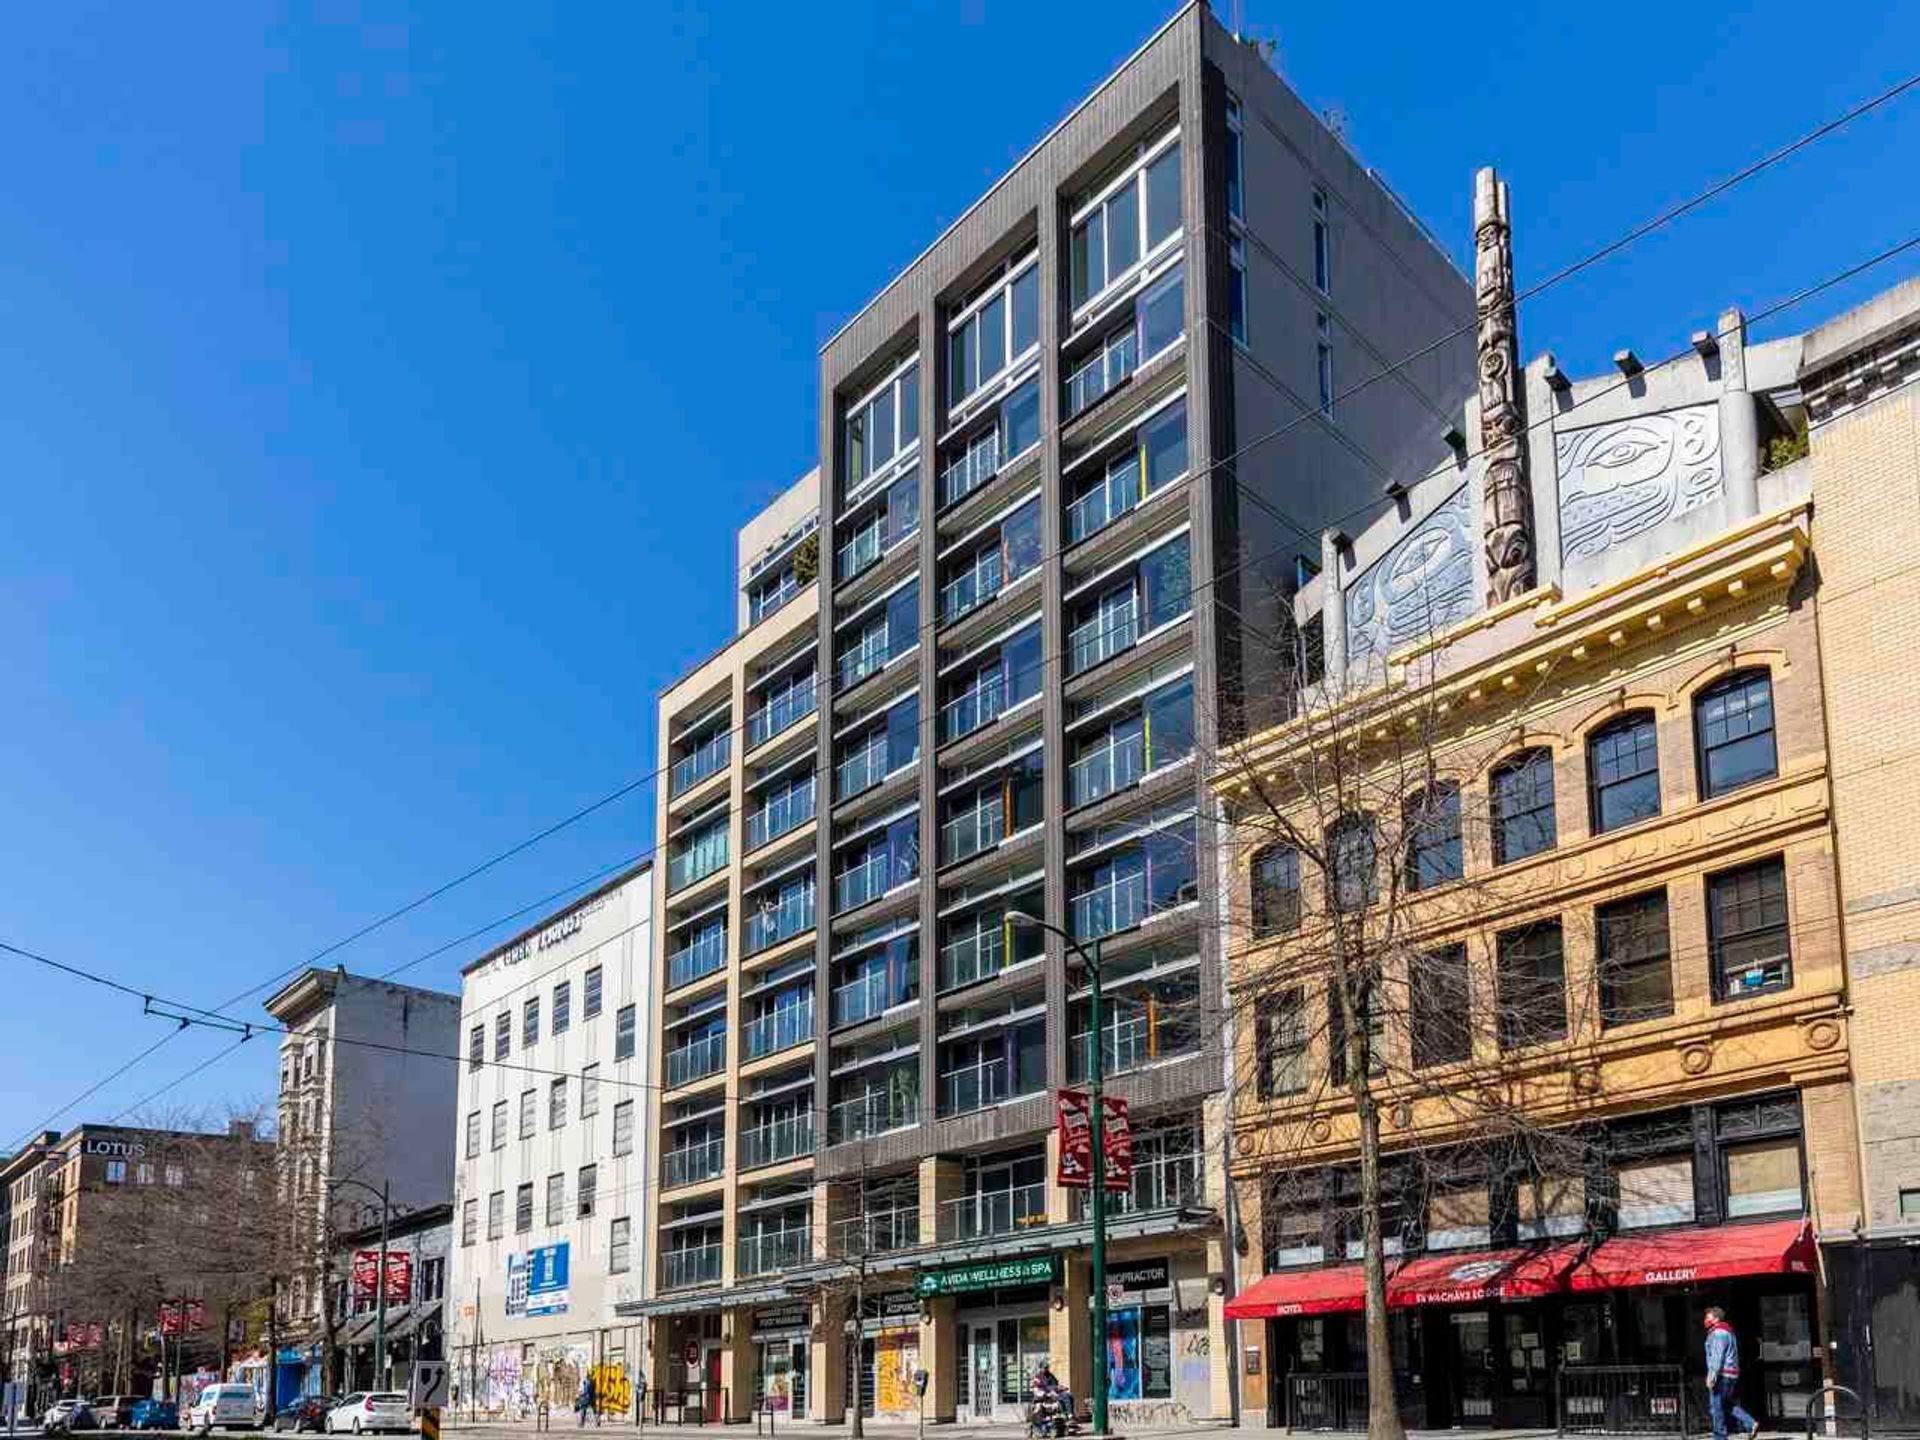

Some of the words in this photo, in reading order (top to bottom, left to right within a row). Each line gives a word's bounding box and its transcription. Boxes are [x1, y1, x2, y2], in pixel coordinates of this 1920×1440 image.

[87, 1140, 145, 1156] LOTUS
[969, 1264, 1021, 1282] WELLNESS
[1030, 1261, 1052, 1276] SPA
[1645, 1267, 1698, 1283] GALLERY
[1472, 1286, 1506, 1300] LODGE
